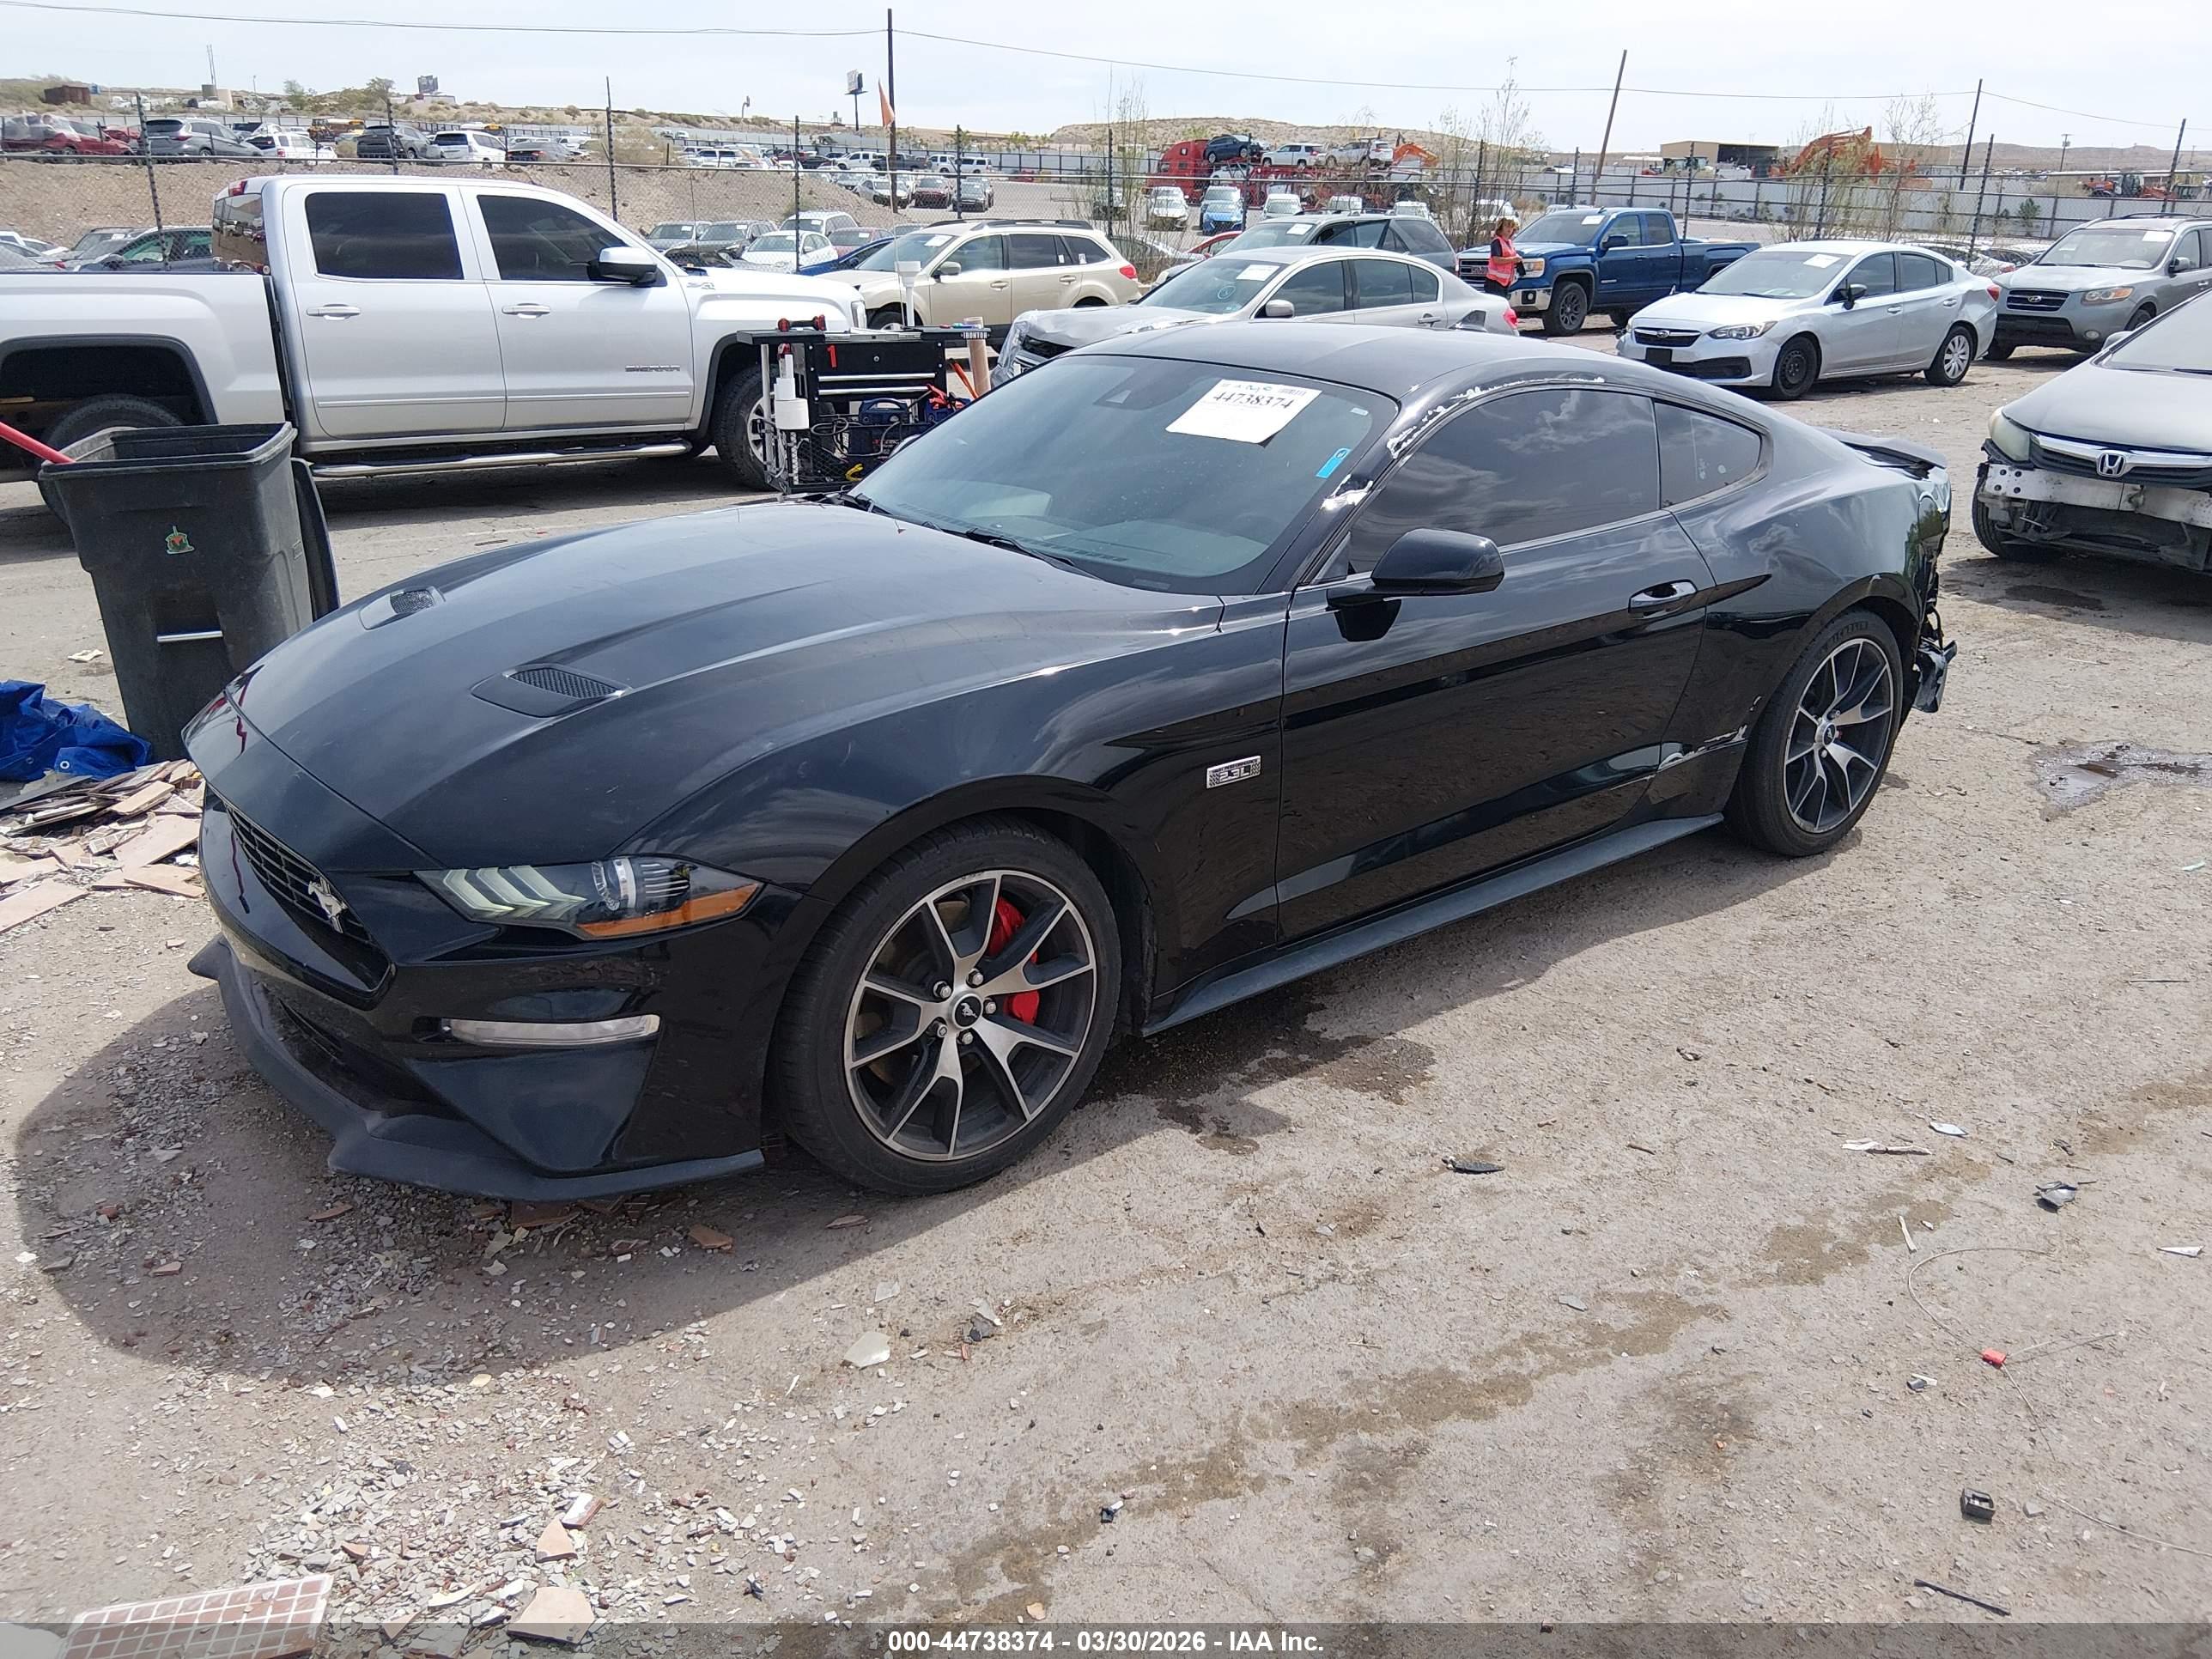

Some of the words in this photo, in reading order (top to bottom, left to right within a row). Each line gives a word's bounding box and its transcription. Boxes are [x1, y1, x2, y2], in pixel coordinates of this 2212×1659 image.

[826, 344, 837, 368] 1
[1212, 392, 1295, 410] 44738374
[1219, 767, 1250, 783] 2.3L
